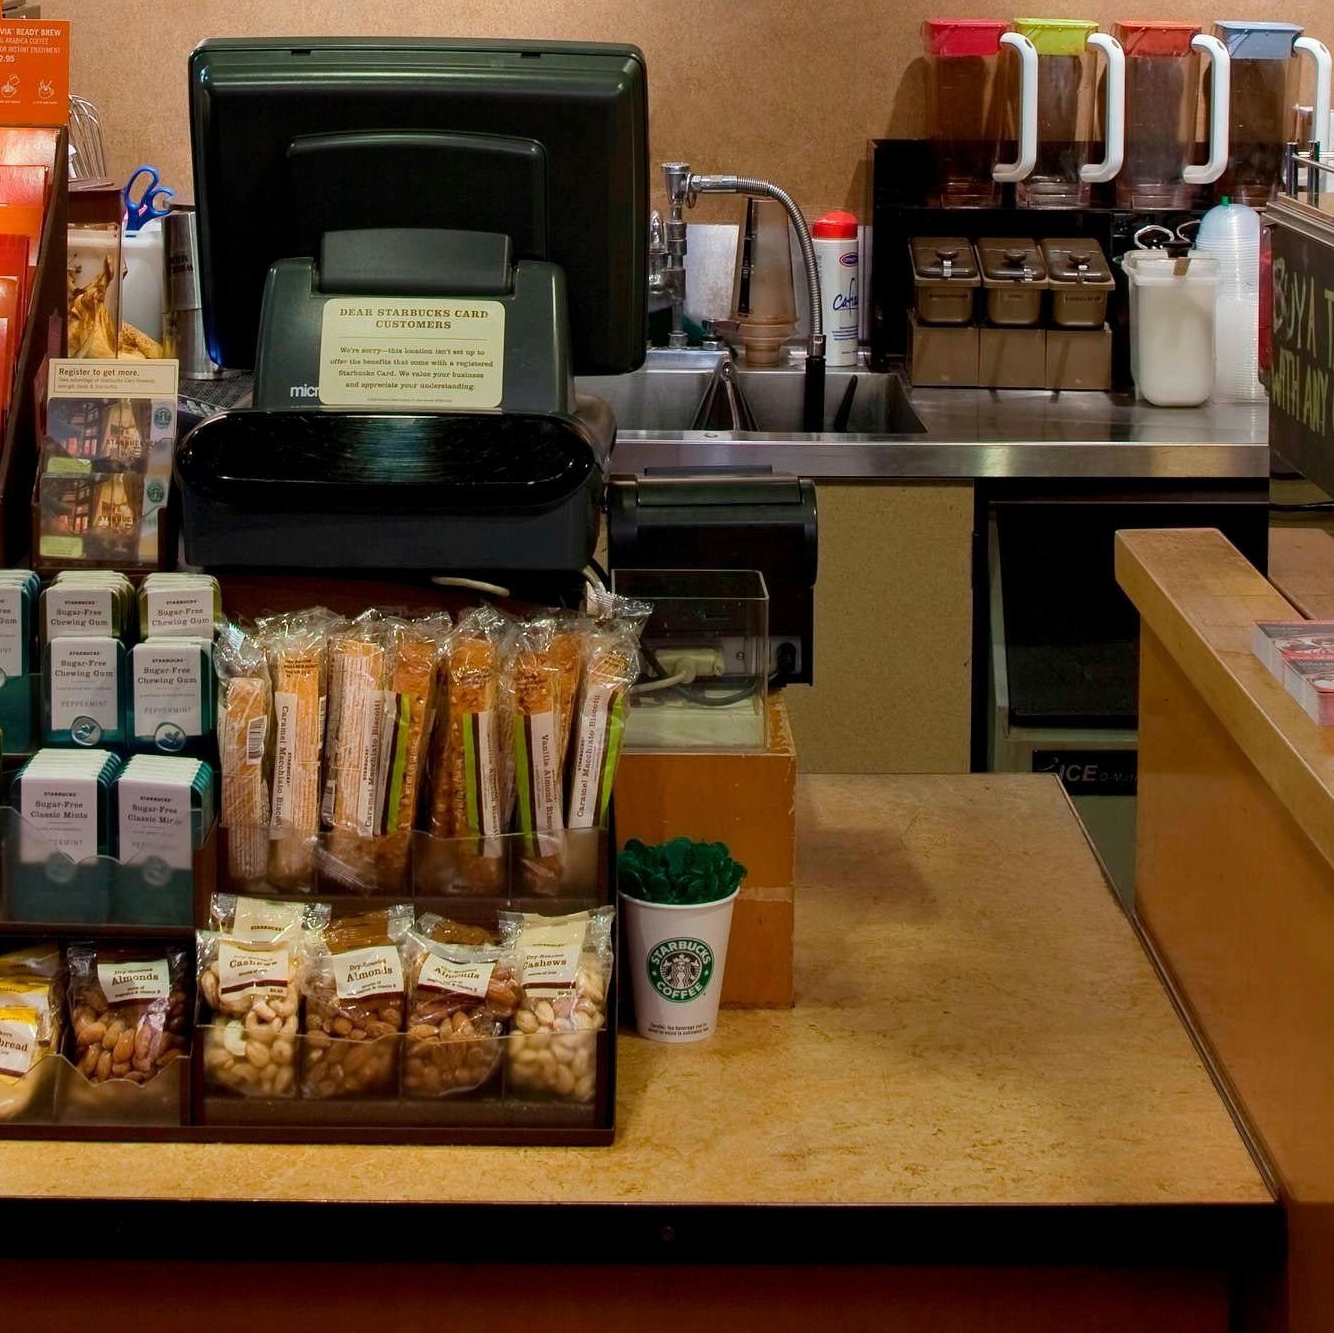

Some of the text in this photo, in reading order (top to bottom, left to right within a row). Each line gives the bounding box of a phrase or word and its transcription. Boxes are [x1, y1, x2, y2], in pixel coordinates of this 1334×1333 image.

[16, 27, 39, 37] READY
[41, 28, 62, 37] BREW
[340, 309, 489, 319] DEAR STARBUCKS CARD
[1273, 257, 1306, 349] BUY
[1307, 277, 1317, 358] A
[375, 320, 451, 330] CUSTOMERS
[59, 367, 140, 378] Register to get more.
[1302, 364, 1329, 437] ANY
[1059, 764, 1098, 783] ICE
[651, 941, 711, 965] STARBUCKS
[112, 972, 159, 986] Almonds
[656, 982, 704, 999] COFFEE
